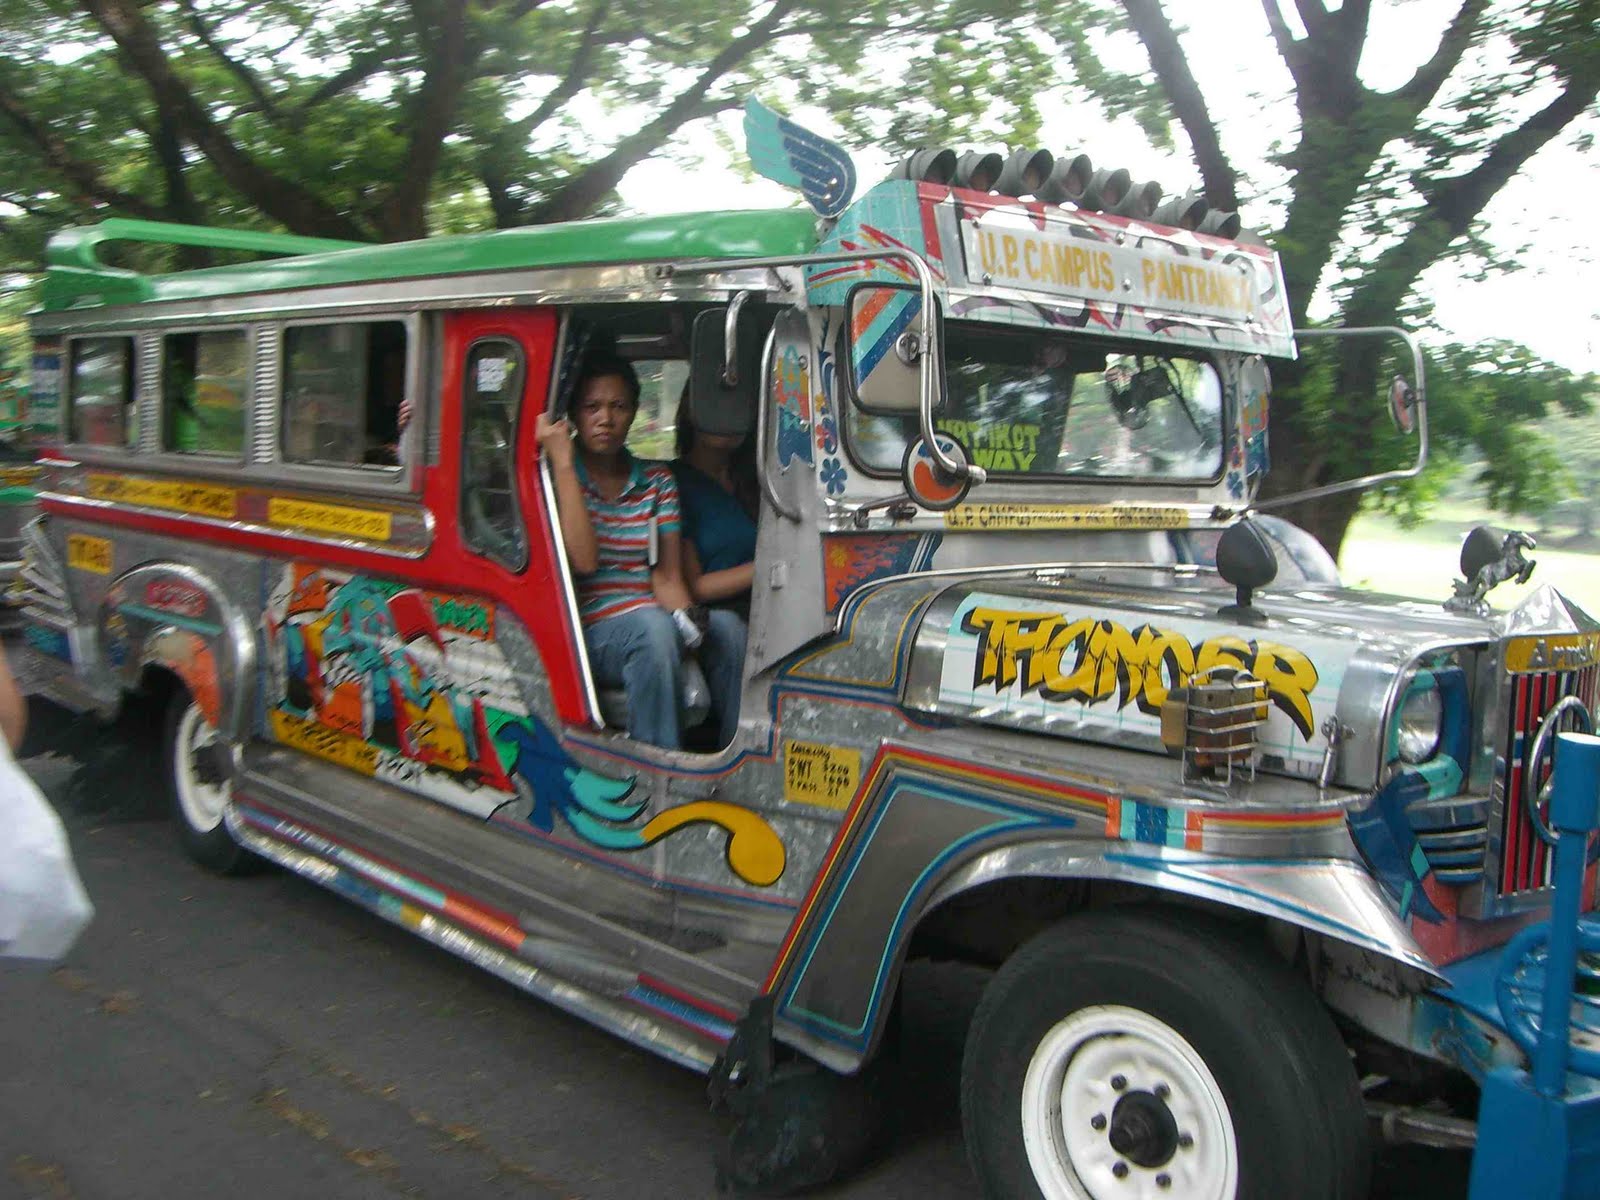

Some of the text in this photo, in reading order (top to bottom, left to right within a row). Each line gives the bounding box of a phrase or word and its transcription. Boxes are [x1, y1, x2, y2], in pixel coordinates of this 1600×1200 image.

[1024, 238, 1115, 292] CAMPUS
[973, 448, 1036, 471] WAY
[961, 606, 1318, 742] THUNDER
